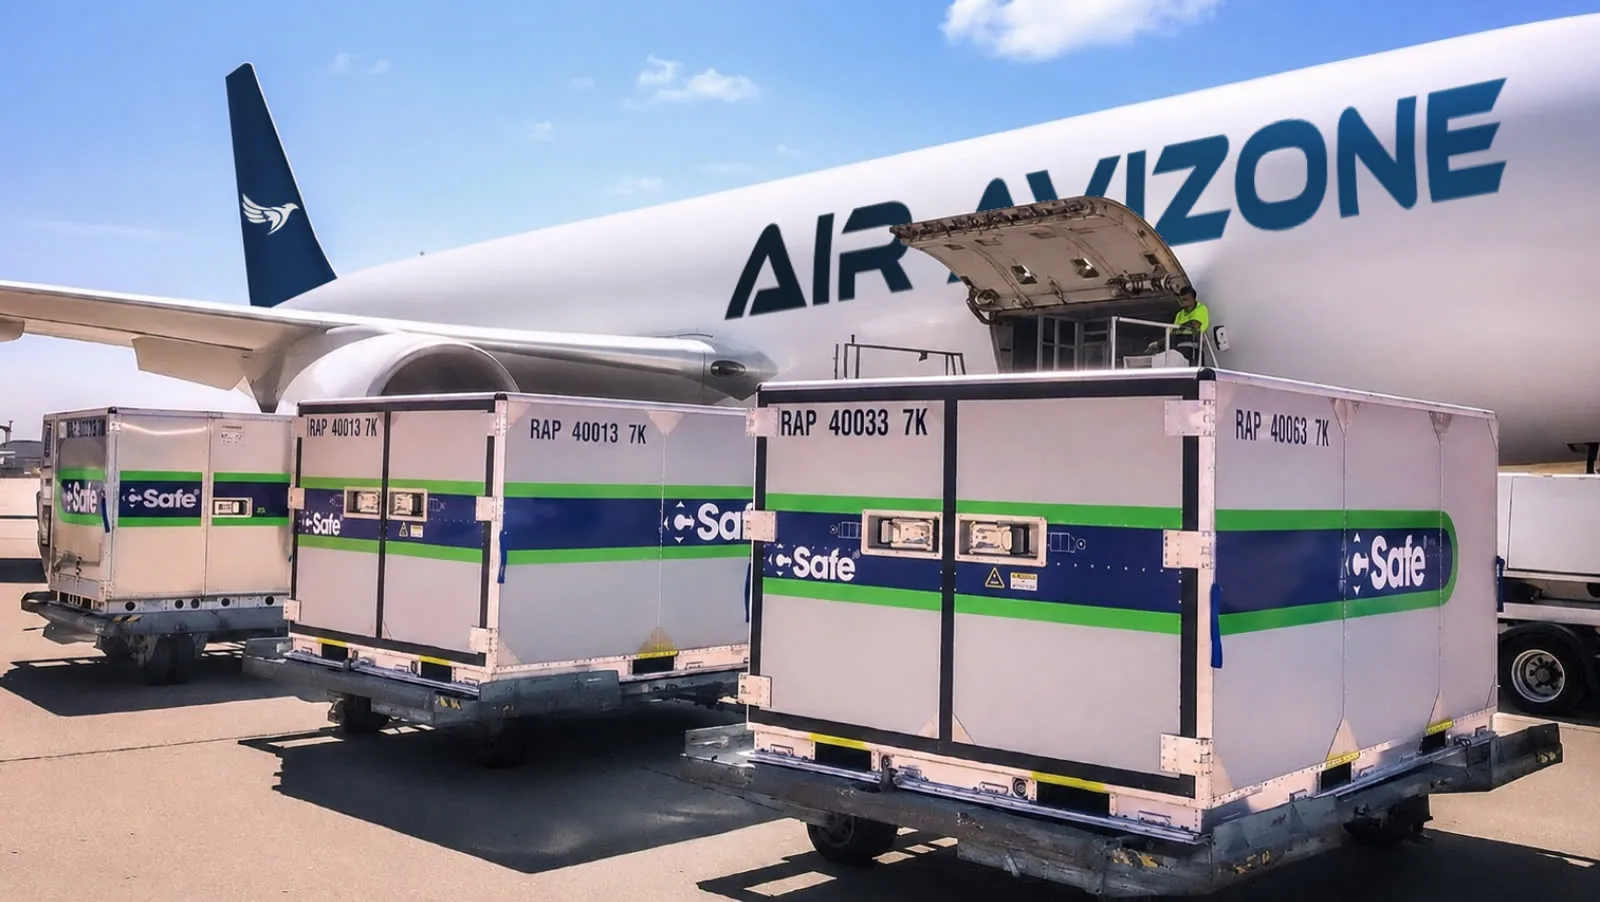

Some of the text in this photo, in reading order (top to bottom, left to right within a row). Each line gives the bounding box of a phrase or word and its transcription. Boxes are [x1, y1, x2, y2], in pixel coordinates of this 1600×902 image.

[725, 202, 912, 320] AIR
[309, 417, 378, 437] RAP 40013 7K
[530, 418, 647, 445] RAP 40013 7K
[782, 407, 929, 437] RAP 40033 7K
[1235, 409, 1331, 447] RAP 40063 7K
